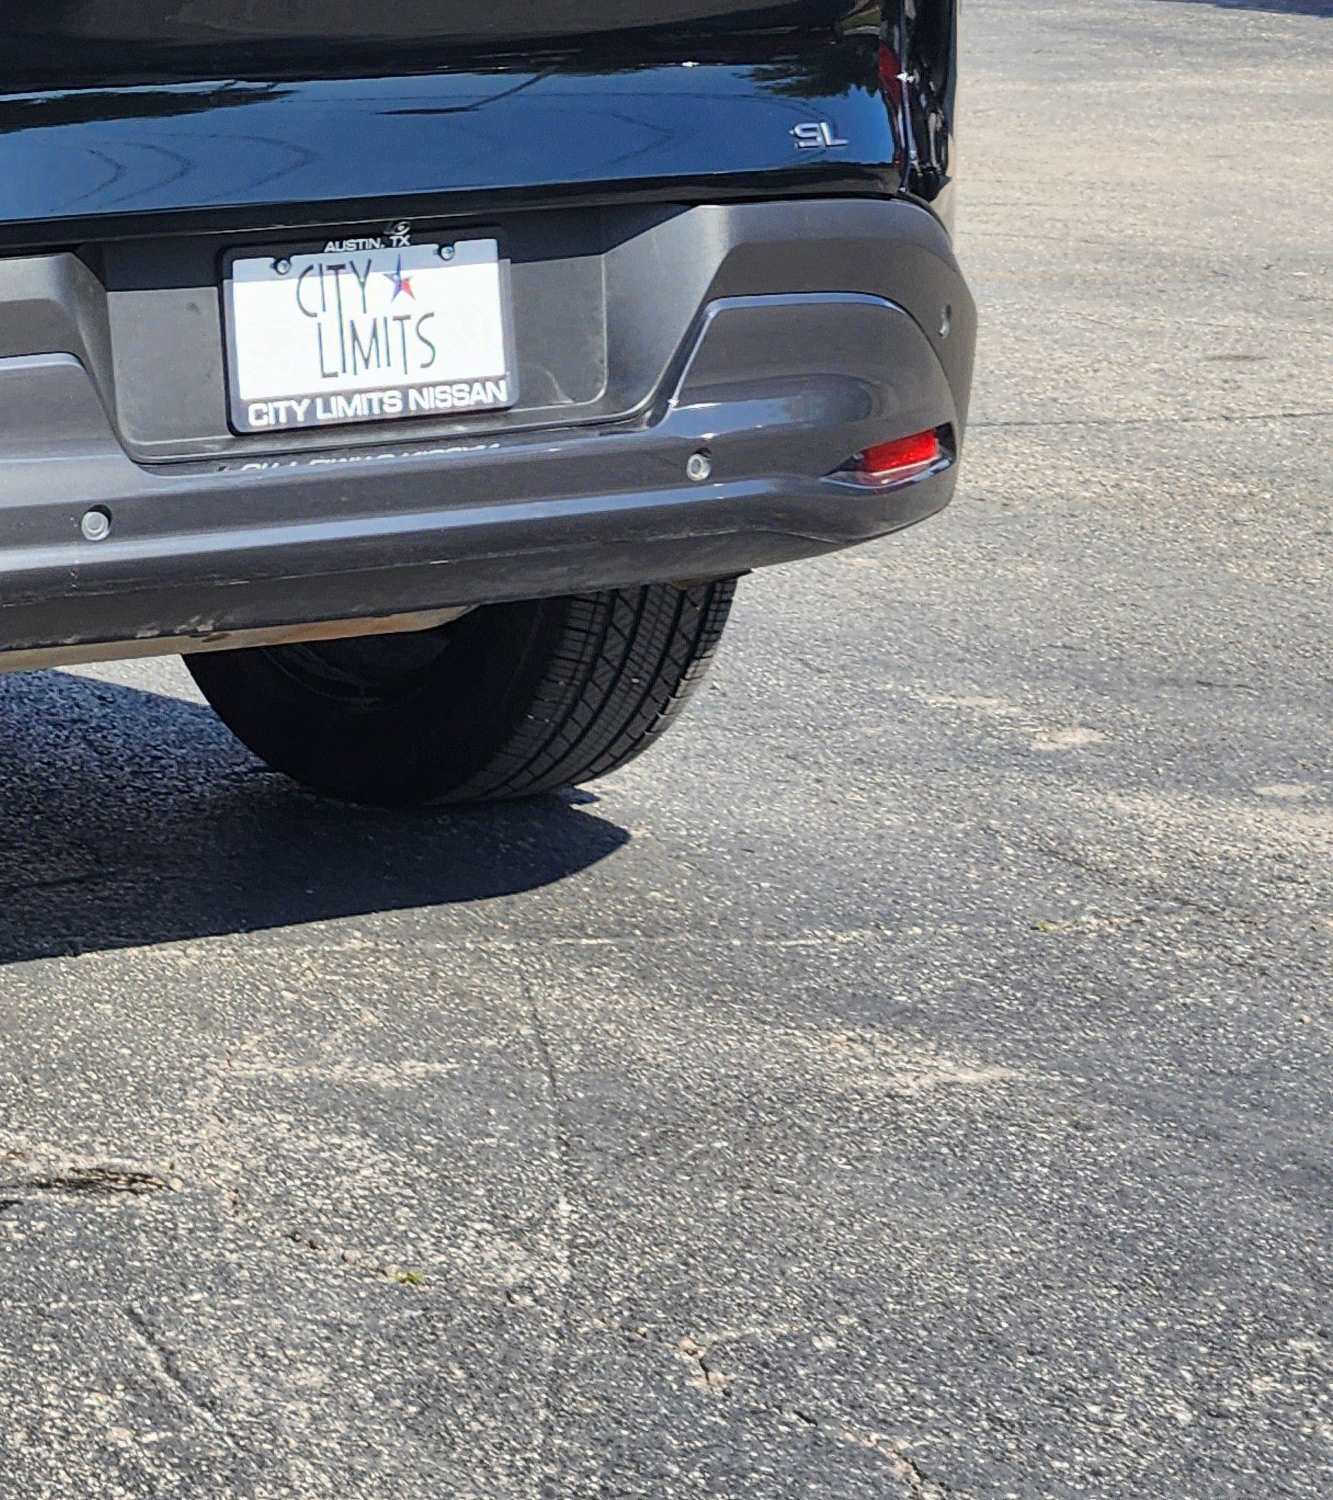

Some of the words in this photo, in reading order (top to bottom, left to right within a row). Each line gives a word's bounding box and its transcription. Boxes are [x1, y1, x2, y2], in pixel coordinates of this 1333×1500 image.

[794, 122, 849, 148] SL
[390, 234, 411, 247] TX
[296, 258, 372, 318] CITY
[317, 312, 436, 378] LIMITS
[248, 398, 312, 427] CITY
[315, 390, 403, 420] LIMITS
[408, 379, 508, 412] NISSAN
